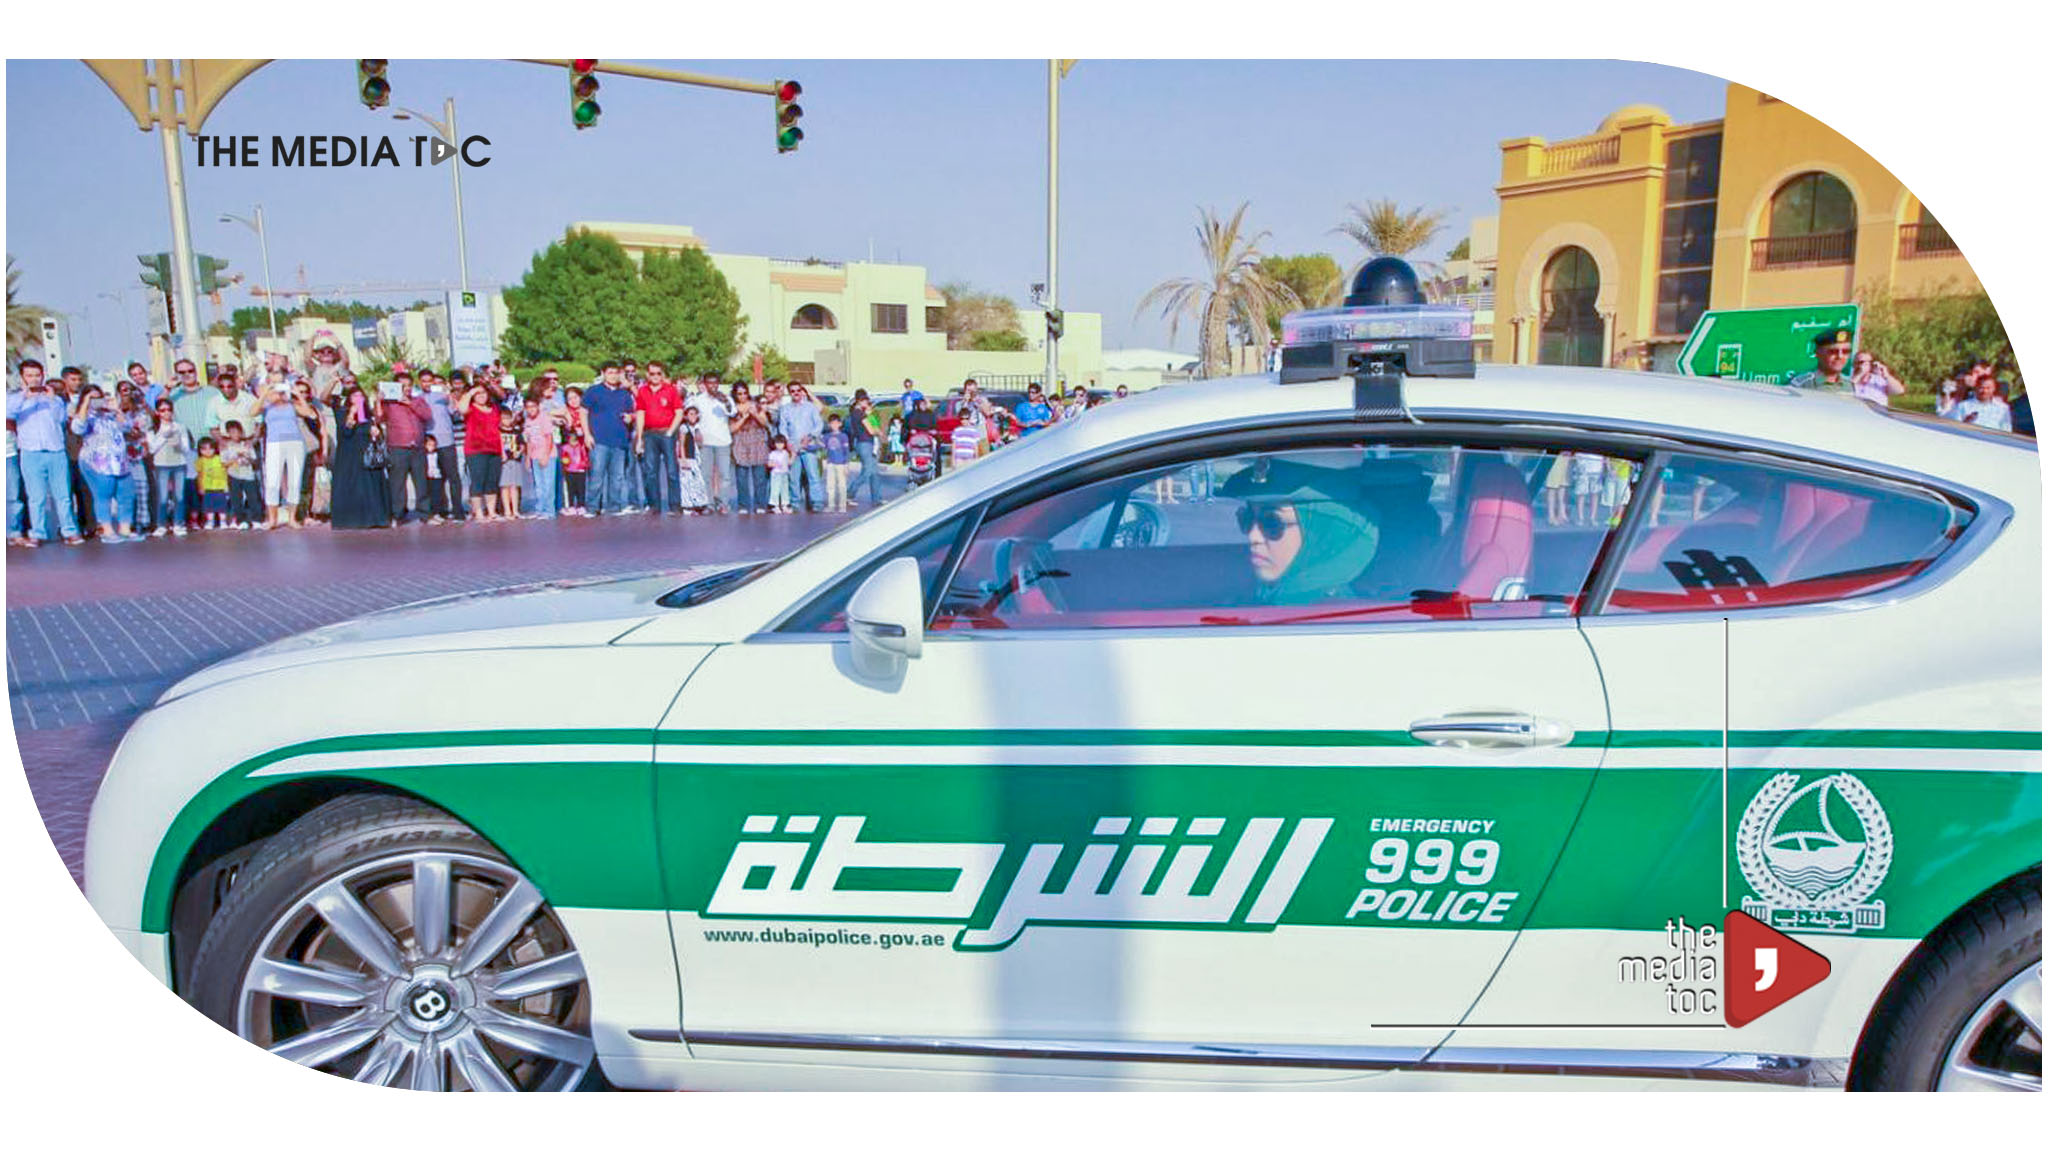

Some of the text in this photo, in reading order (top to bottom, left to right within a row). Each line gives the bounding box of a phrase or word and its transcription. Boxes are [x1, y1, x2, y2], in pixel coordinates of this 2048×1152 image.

[1370, 818, 1496, 834] EMERGENCY
[1365, 837, 1500, 886] 999
[706, 815, 1335, 945] الشرطة
[1345, 888, 1519, 923] POLICE
[703, 927, 946, 950] www.dubaipolice.gov.ae
